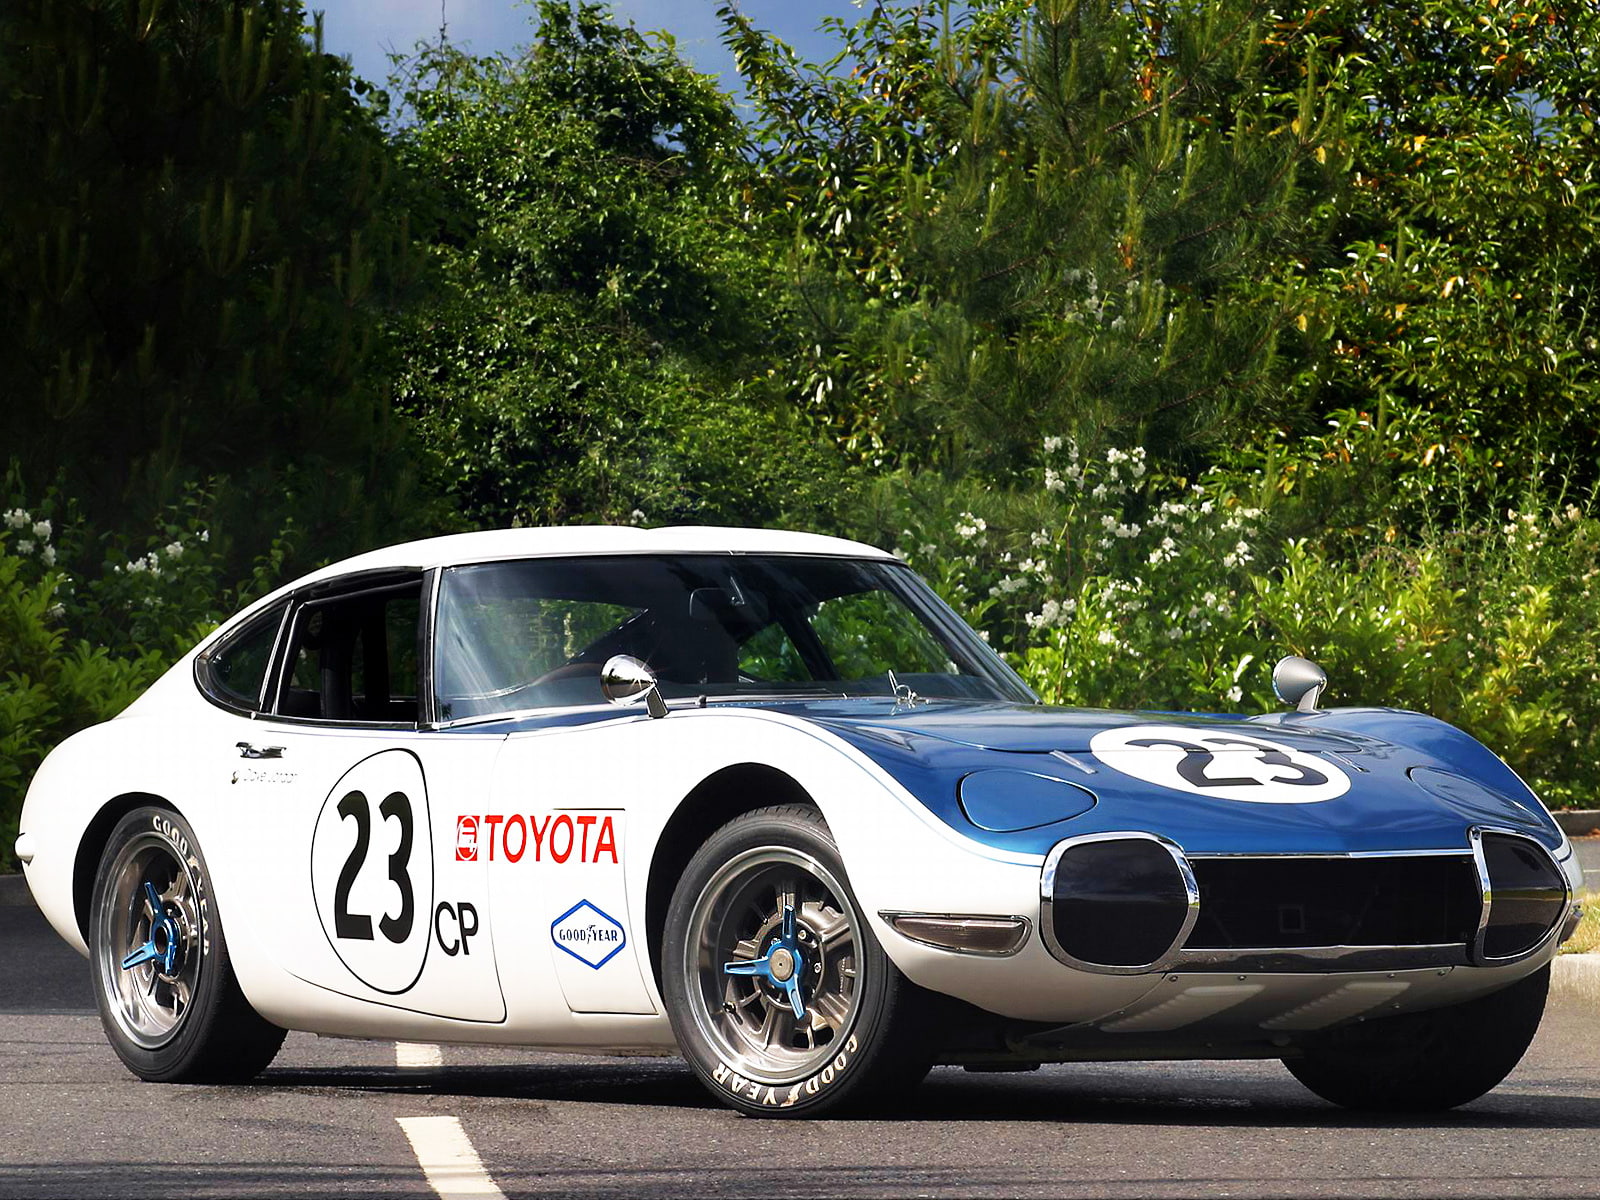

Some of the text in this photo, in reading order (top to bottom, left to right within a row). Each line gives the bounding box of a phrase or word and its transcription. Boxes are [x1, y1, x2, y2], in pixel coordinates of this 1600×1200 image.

[1124, 737, 1329, 788] 23
[484, 813, 619, 865] TOYOTA
[334, 789, 415, 944] 23
[435, 901, 479, 957] CP
